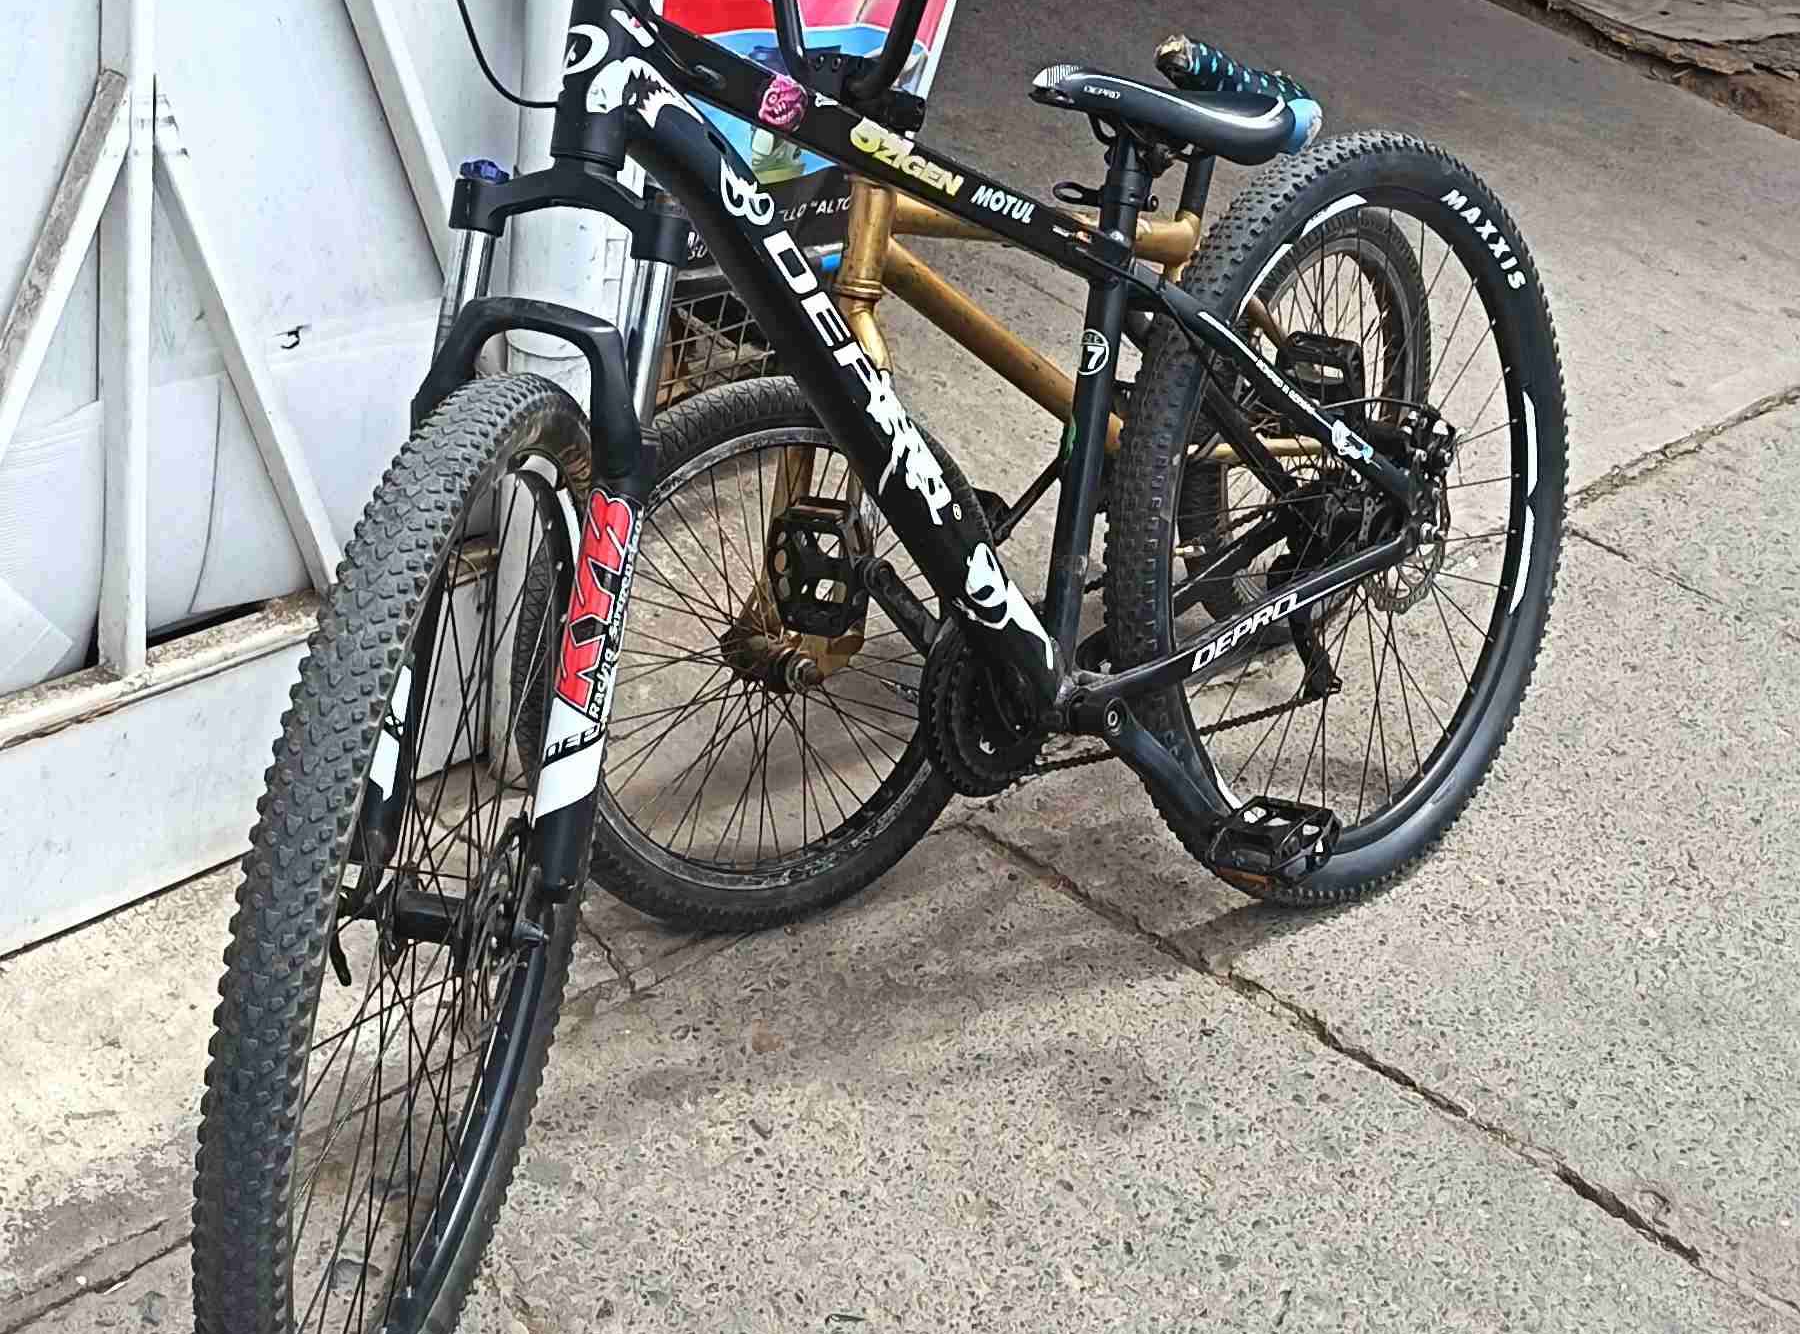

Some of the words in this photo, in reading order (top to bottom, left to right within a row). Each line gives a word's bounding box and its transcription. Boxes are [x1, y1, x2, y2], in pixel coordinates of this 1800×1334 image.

[971, 185, 1035, 224] MOTUL
[1439, 188, 1527, 292] MAXXIS
[555, 488, 633, 711] KYB
[1192, 592, 1298, 673] DEPRO
